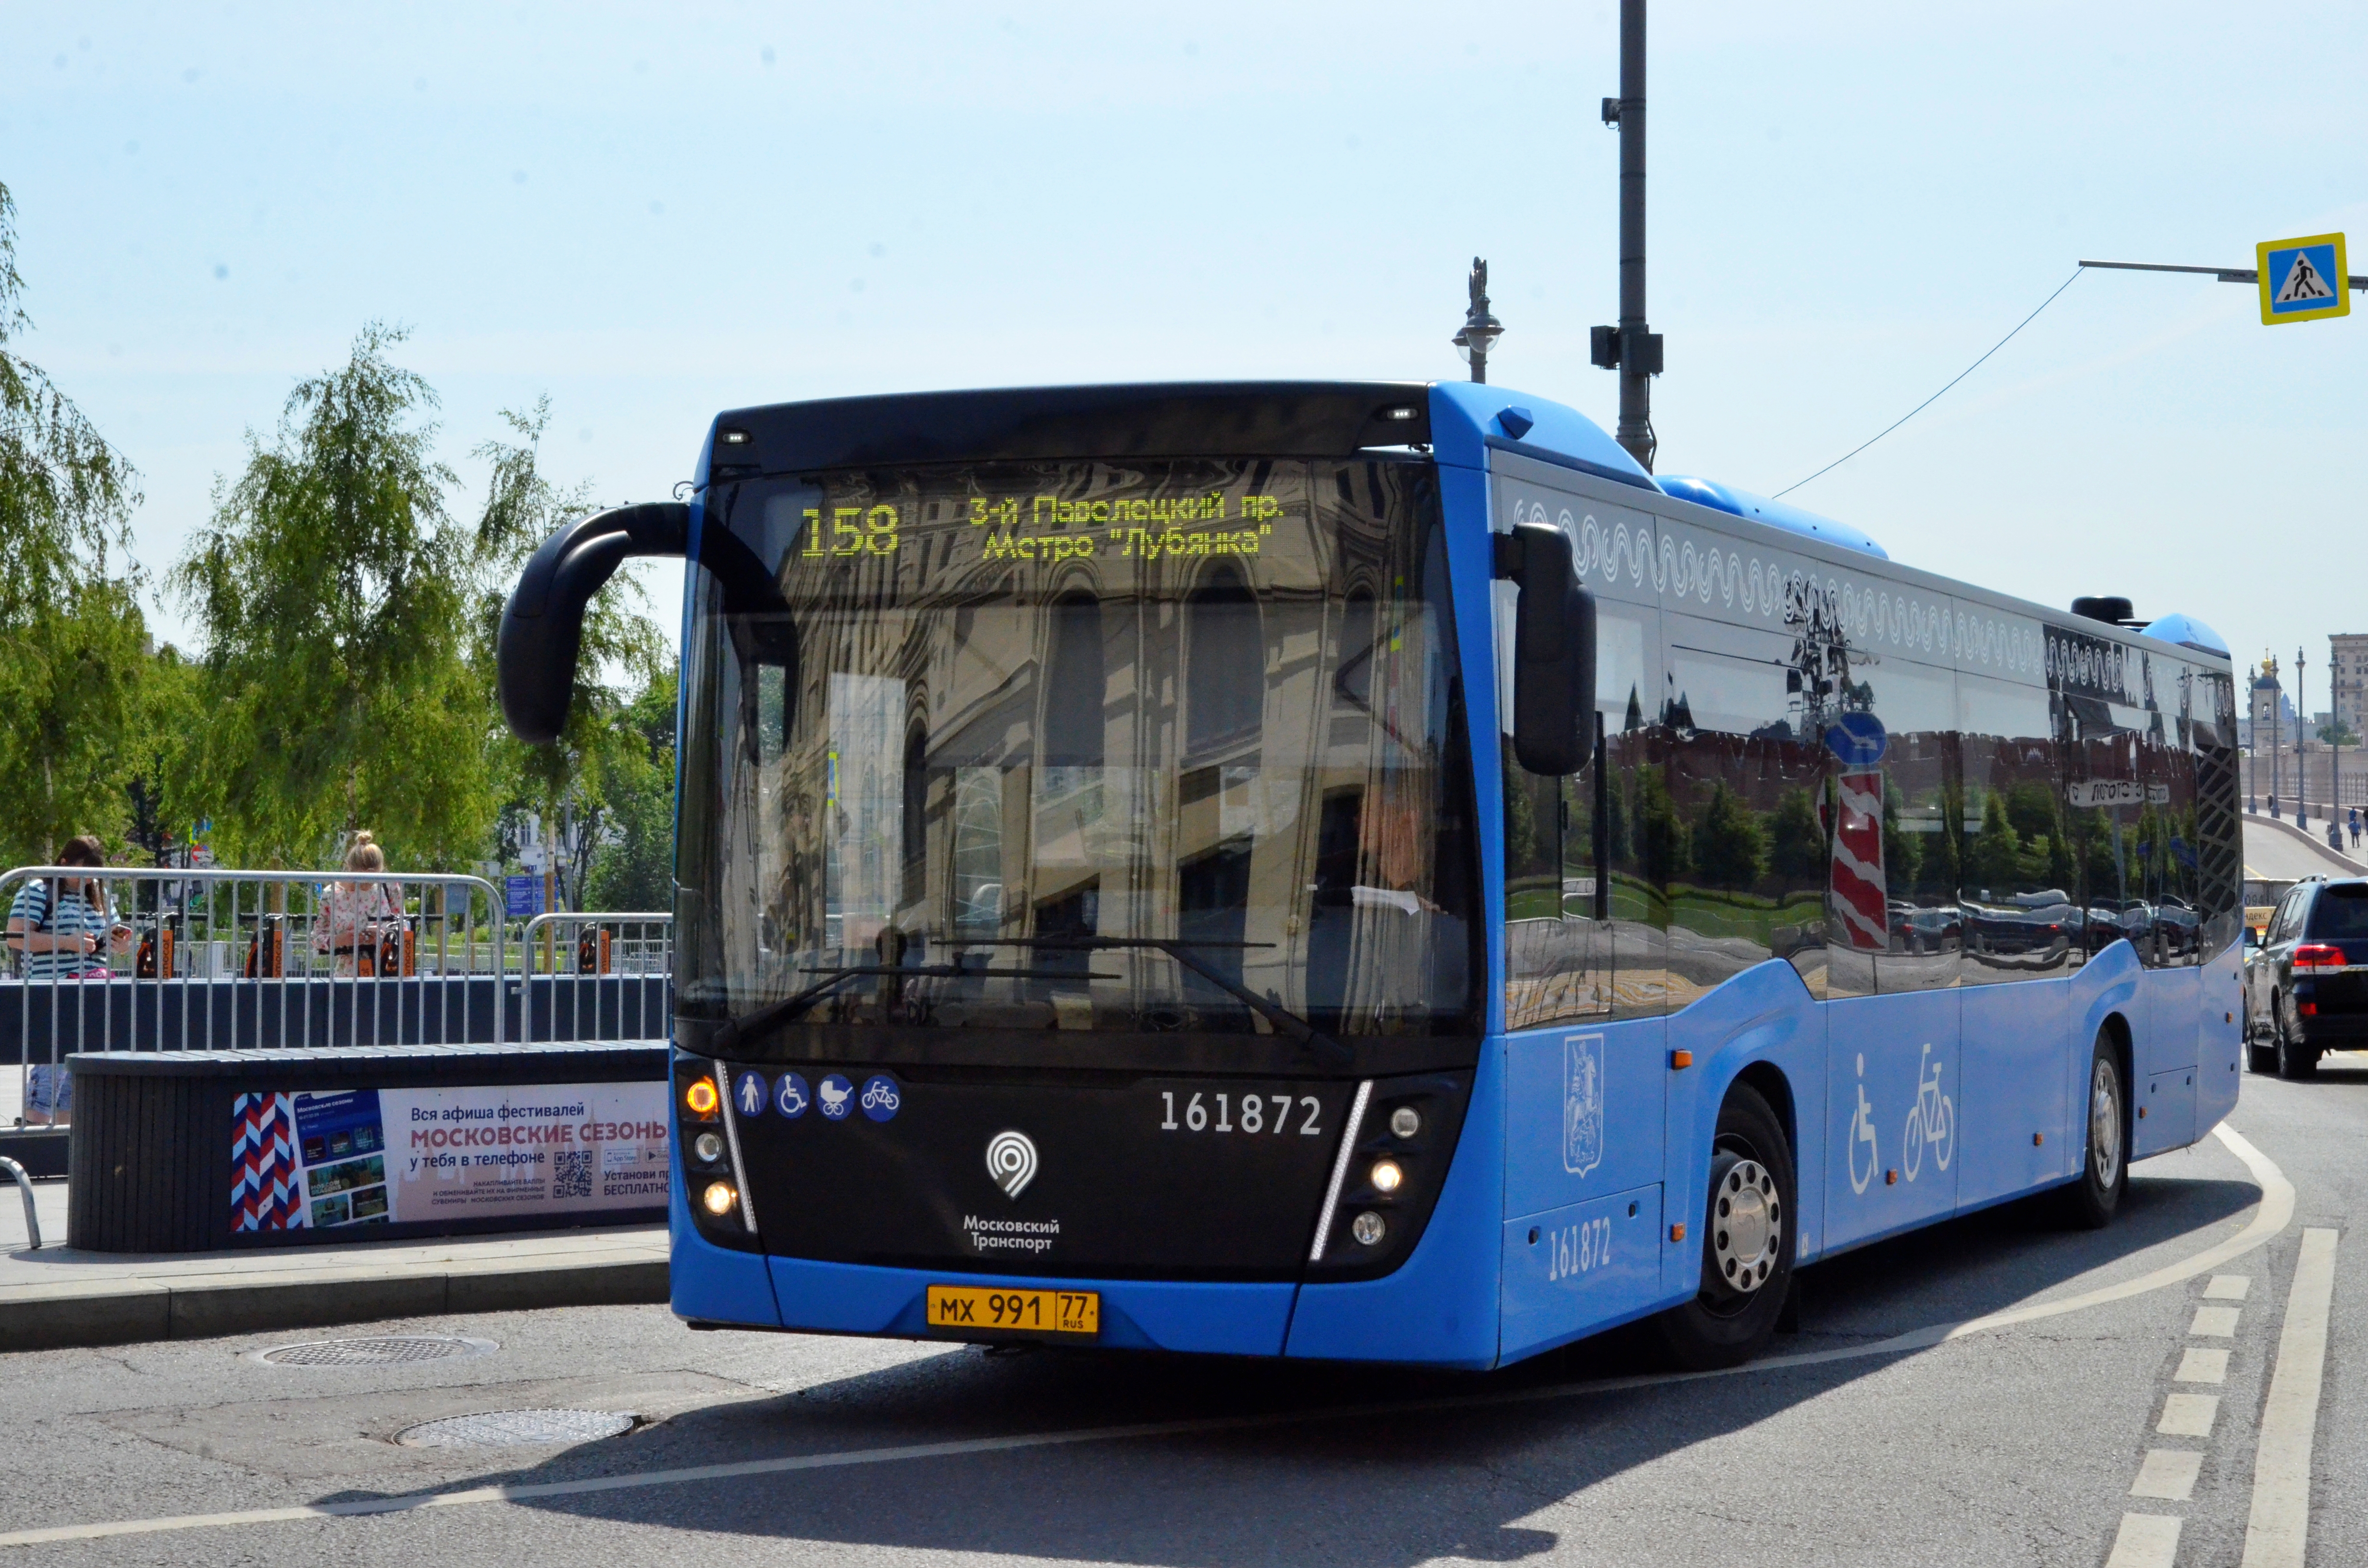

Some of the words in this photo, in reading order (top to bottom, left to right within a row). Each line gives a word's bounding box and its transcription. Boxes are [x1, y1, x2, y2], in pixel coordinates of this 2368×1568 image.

[970, 496, 1018, 524] 3-й
[1241, 495, 1284, 521] пр.
[802, 504, 899, 556] 158
[983, 532, 1094, 562] Метро
[1110, 525, 1271, 560] "Лубянка"
[411, 1107, 437, 1121] Вся
[442, 1106, 493, 1123] афиша
[497, 1102, 584, 1122] фестивалей
[1161, 1091, 1321, 1135] 161872
[411, 1125, 573, 1148] МОСКОВСКИЕ
[410, 1157, 418, 1171] у
[422, 1153, 456, 1167] тебя
[461, 1155, 469, 1166] в
[474, 1151, 545, 1168] телефоне
[604, 1170, 656, 1181] Установи
[439, 1188, 485, 1196] ОБМЕНИВАЙТЕ
[963, 1214, 1060, 1234] Московский
[971, 1231, 1052, 1253] Транспорт
[1550, 1216, 1610, 1281] 161872
[941, 1298, 975, 1322] МХ
[989, 1294, 1040, 1326] 991
[1060, 1295, 1088, 1319] 77
[1062, 1319, 1084, 1329] RUS
